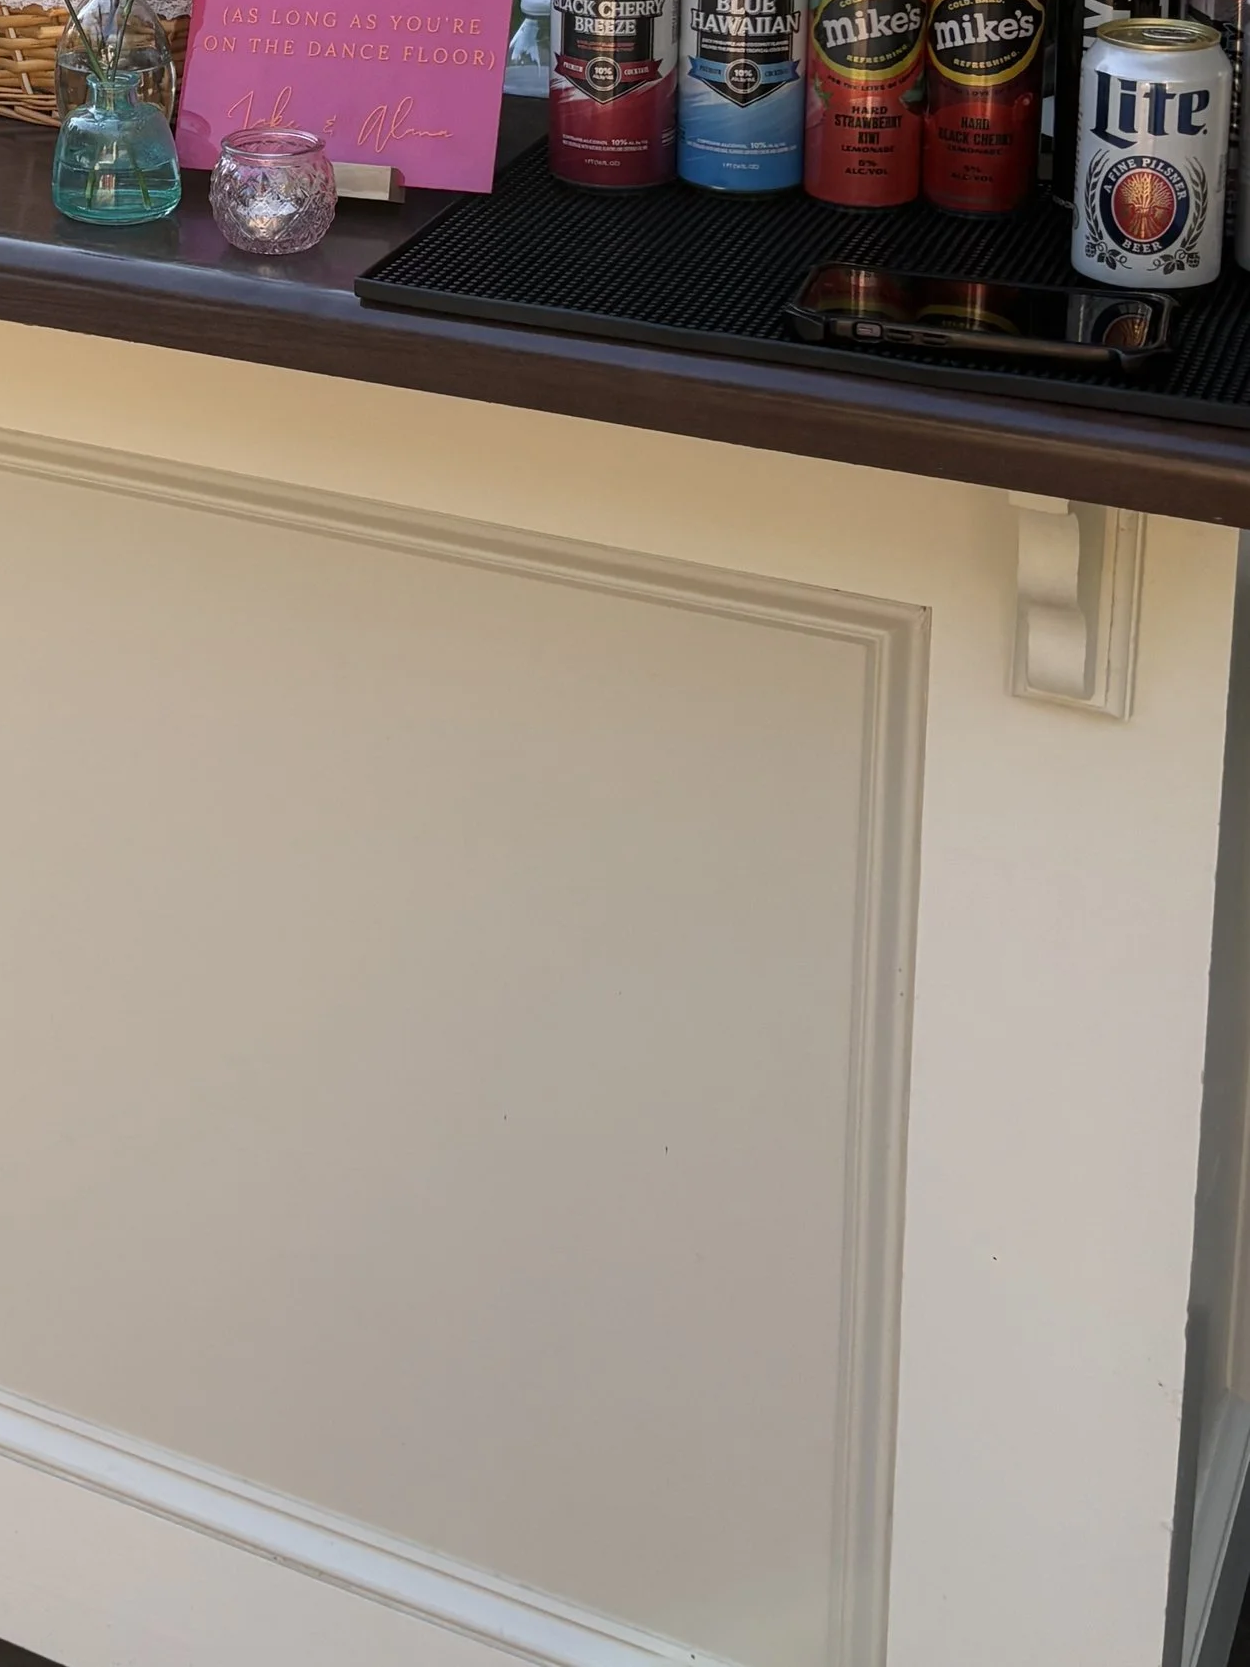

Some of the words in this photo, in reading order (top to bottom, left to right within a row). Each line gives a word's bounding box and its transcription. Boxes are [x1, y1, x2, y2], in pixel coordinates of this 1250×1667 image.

[222, 6, 259, 26] (AS
[271, 9, 337, 29] LONG
[349, 13, 378, 31] AS
[389, 14, 482, 35] YOU'RE
[574, 16, 637, 36] BREEZE
[690, 9, 802, 37] HAWAIIAN
[822, 3, 922, 49] mike's
[933, 9, 1035, 51] mike's
[203, 34, 238, 53] ON
[249, 37, 295, 56] THE
[307, 40, 390, 62] DANCE
[402, 45, 496, 71] FLOOR)
[594, 67, 613, 75] 10%
[733, 69, 753, 77] 10%
[851, 105, 889, 115] HARD
[323, 114, 337, 136] &
[834, 114, 904, 130] STRAWBERRY
[960, 116, 990, 131] HARD
[611, 138, 627, 146] 10%
[937, 127, 969, 145] BLACK
[1103, 184, 1112, 194] A
[1108, 157, 1136, 182] FINE
[1141, 157, 1188, 201] PILSNER
[1121, 238, 1163, 254] BEER
